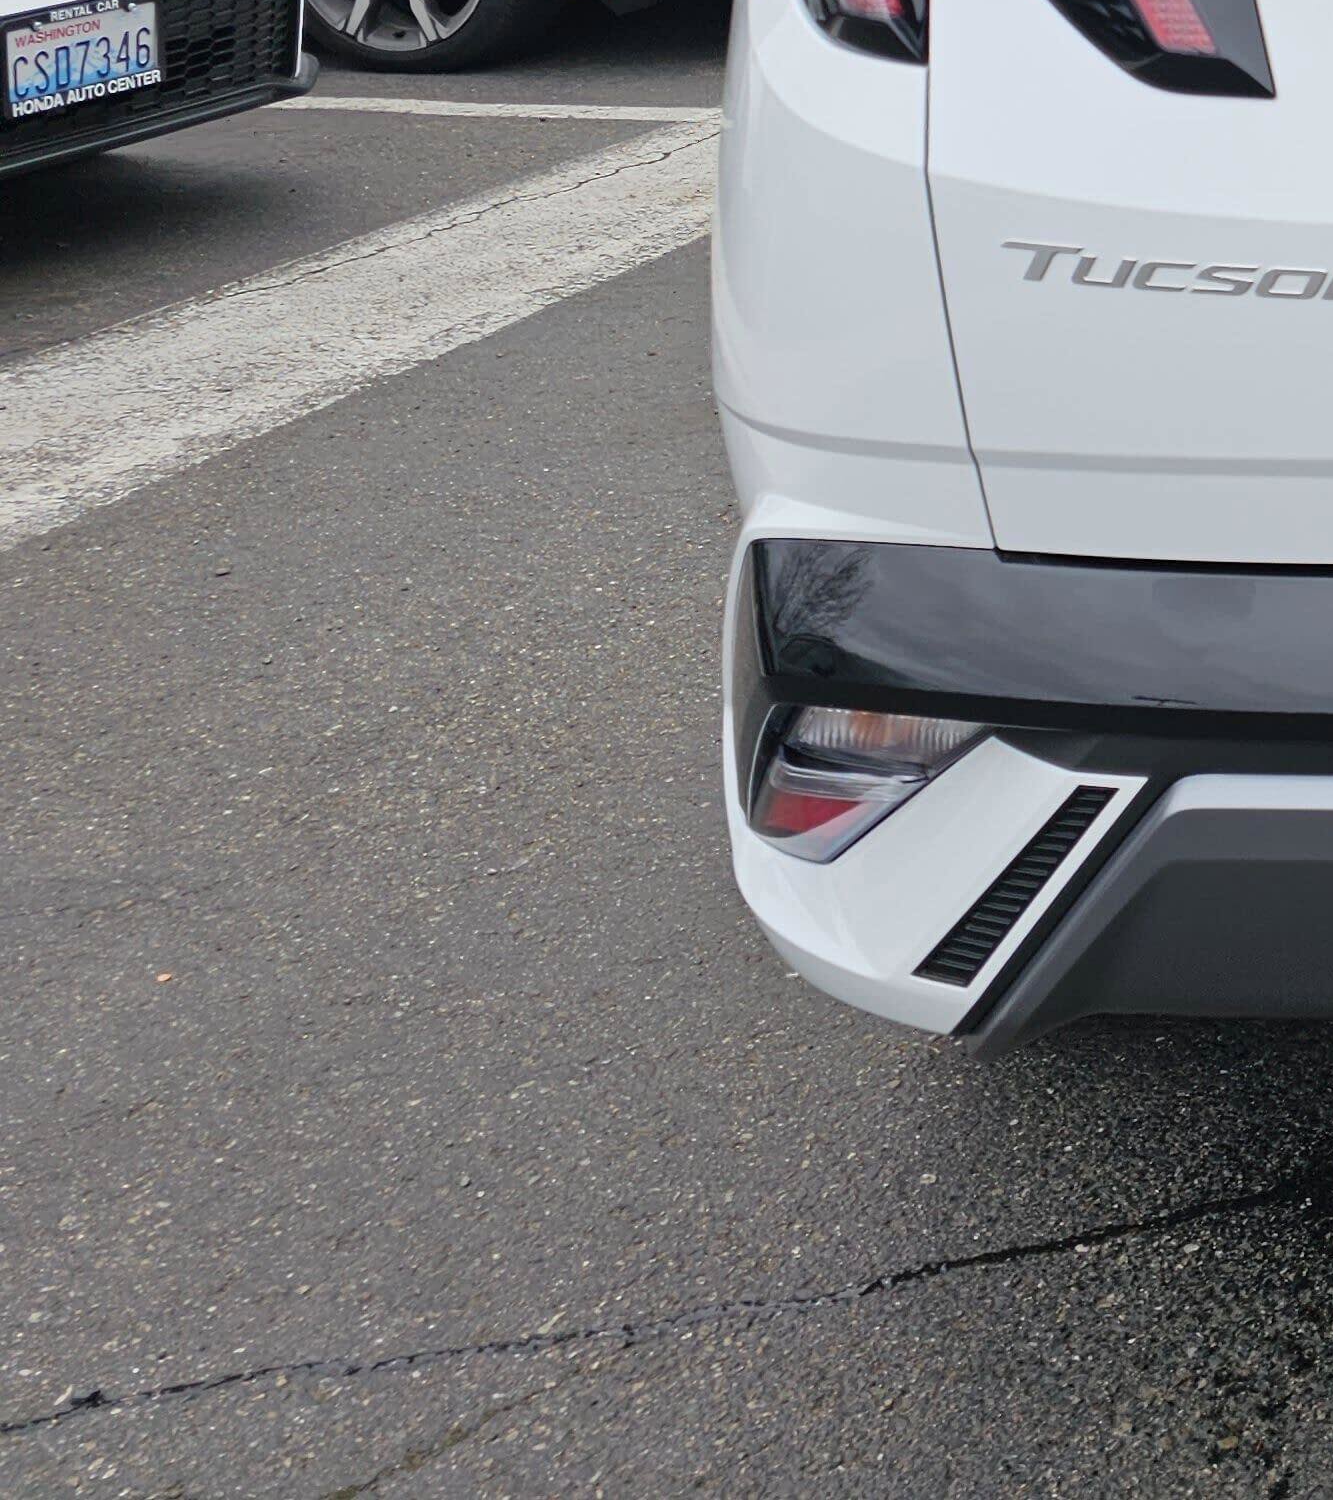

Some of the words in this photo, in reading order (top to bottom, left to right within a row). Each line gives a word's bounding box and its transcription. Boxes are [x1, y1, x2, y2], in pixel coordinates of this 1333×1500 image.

[50, 6, 92, 22] RENTAL
[96, 0, 119, 12] CAR
[15, 19, 101, 48] WASHINGTON
[13, 27, 150, 98] CSD7346
[12, 94, 64, 117] HONDA
[66, 83, 105, 104] AUTO
[107, 69, 161, 94] CENTER
